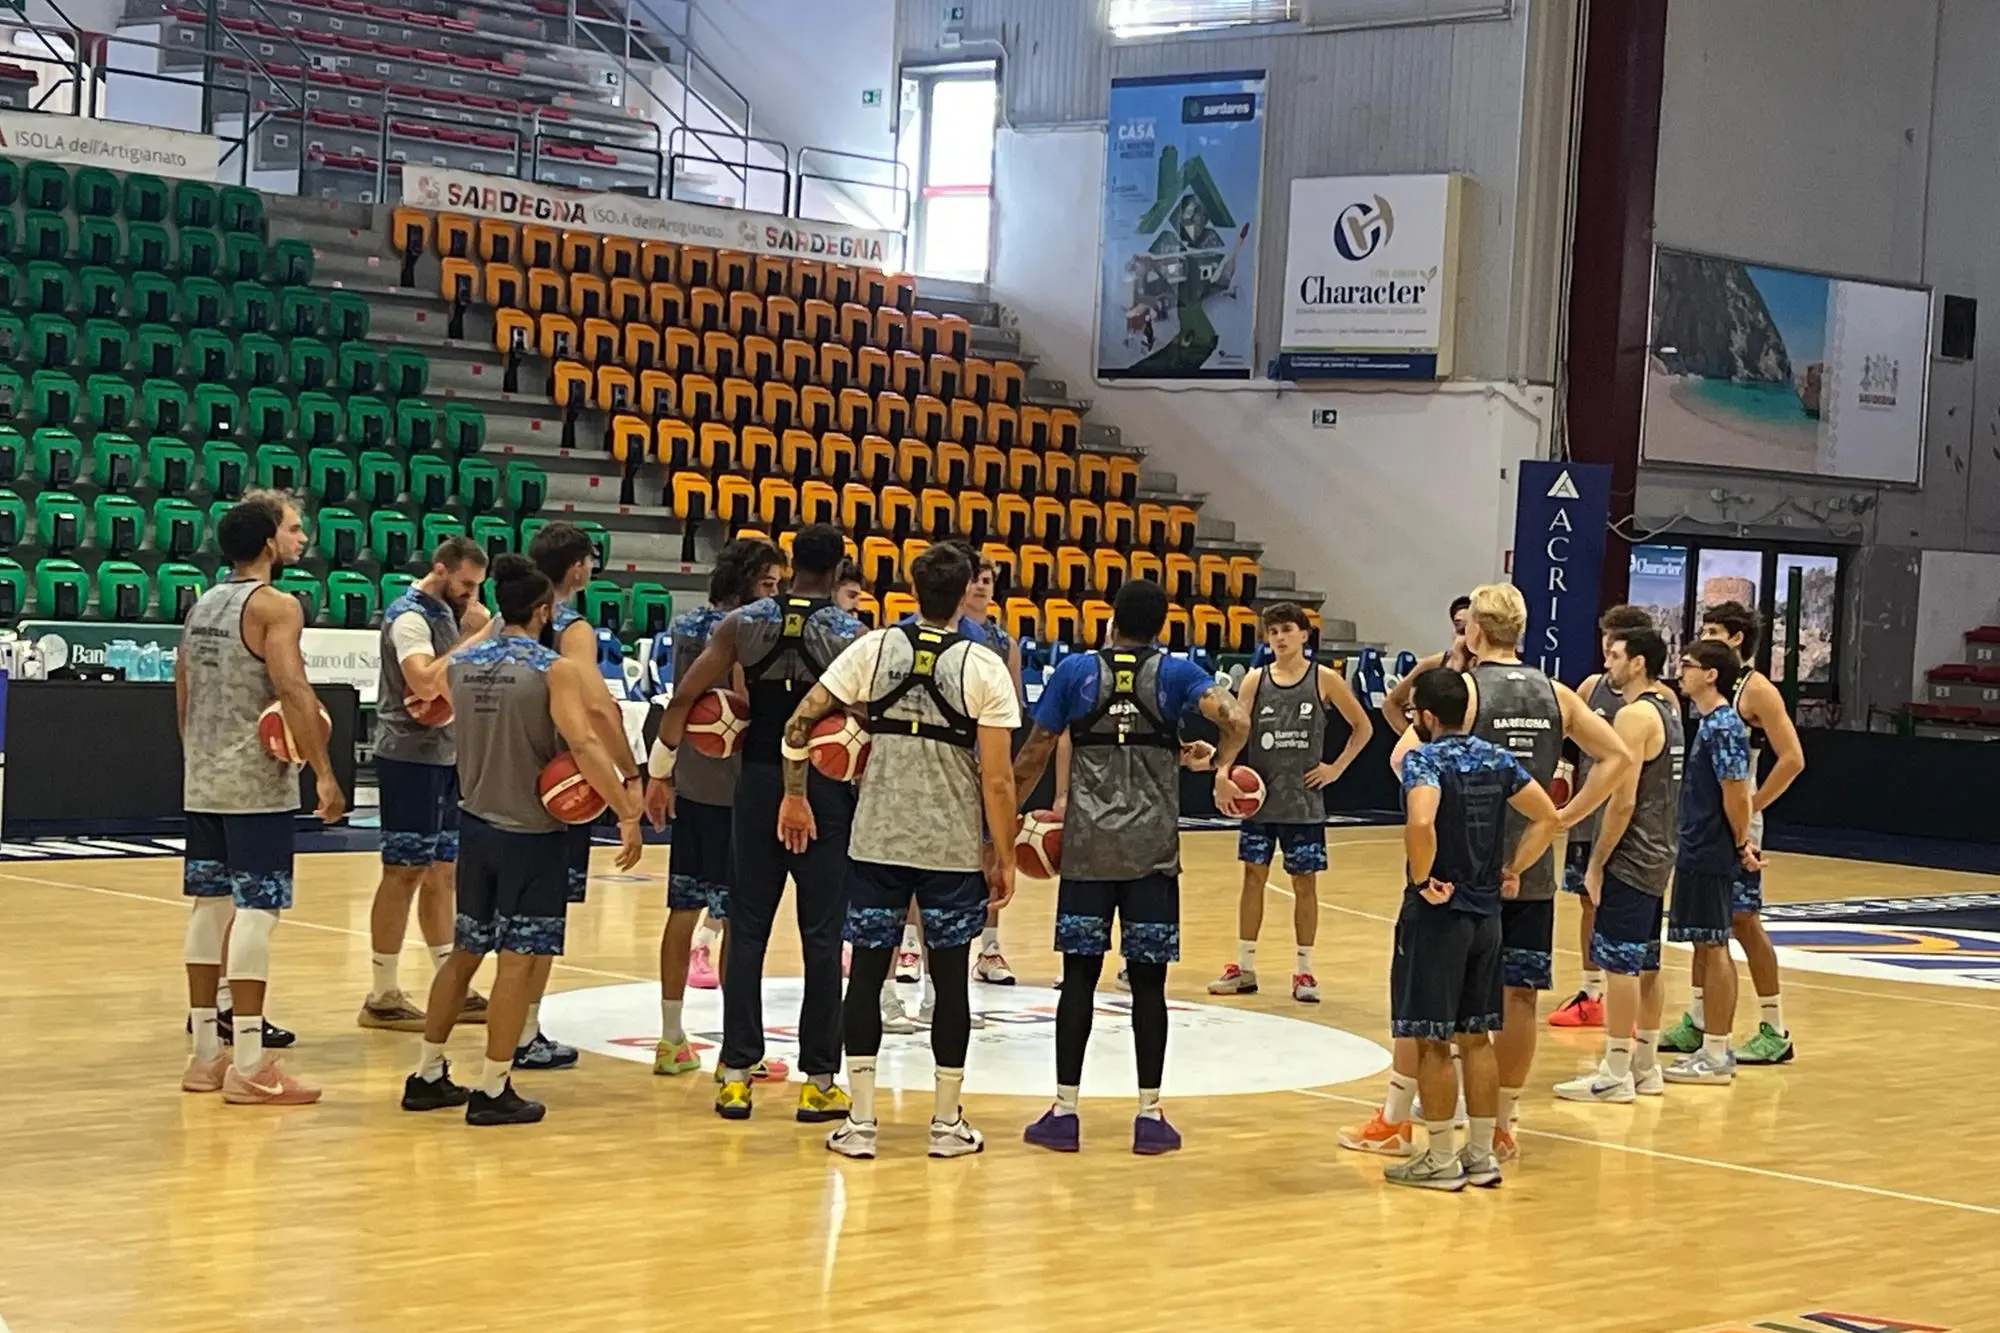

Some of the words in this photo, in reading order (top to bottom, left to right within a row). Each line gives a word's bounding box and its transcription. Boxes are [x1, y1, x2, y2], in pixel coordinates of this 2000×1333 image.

[1118, 123, 1156, 140] CASA
[15, 130, 65, 150] ISOLA
[68, 137, 187, 166] dell'Artigianato
[448, 183, 588, 225] SARDEGNA
[765, 226, 882, 262] SARDEGNA
[1300, 275, 1426, 305] Character
[302, 651, 341, 669] anco
[343, 651, 356, 669] di
